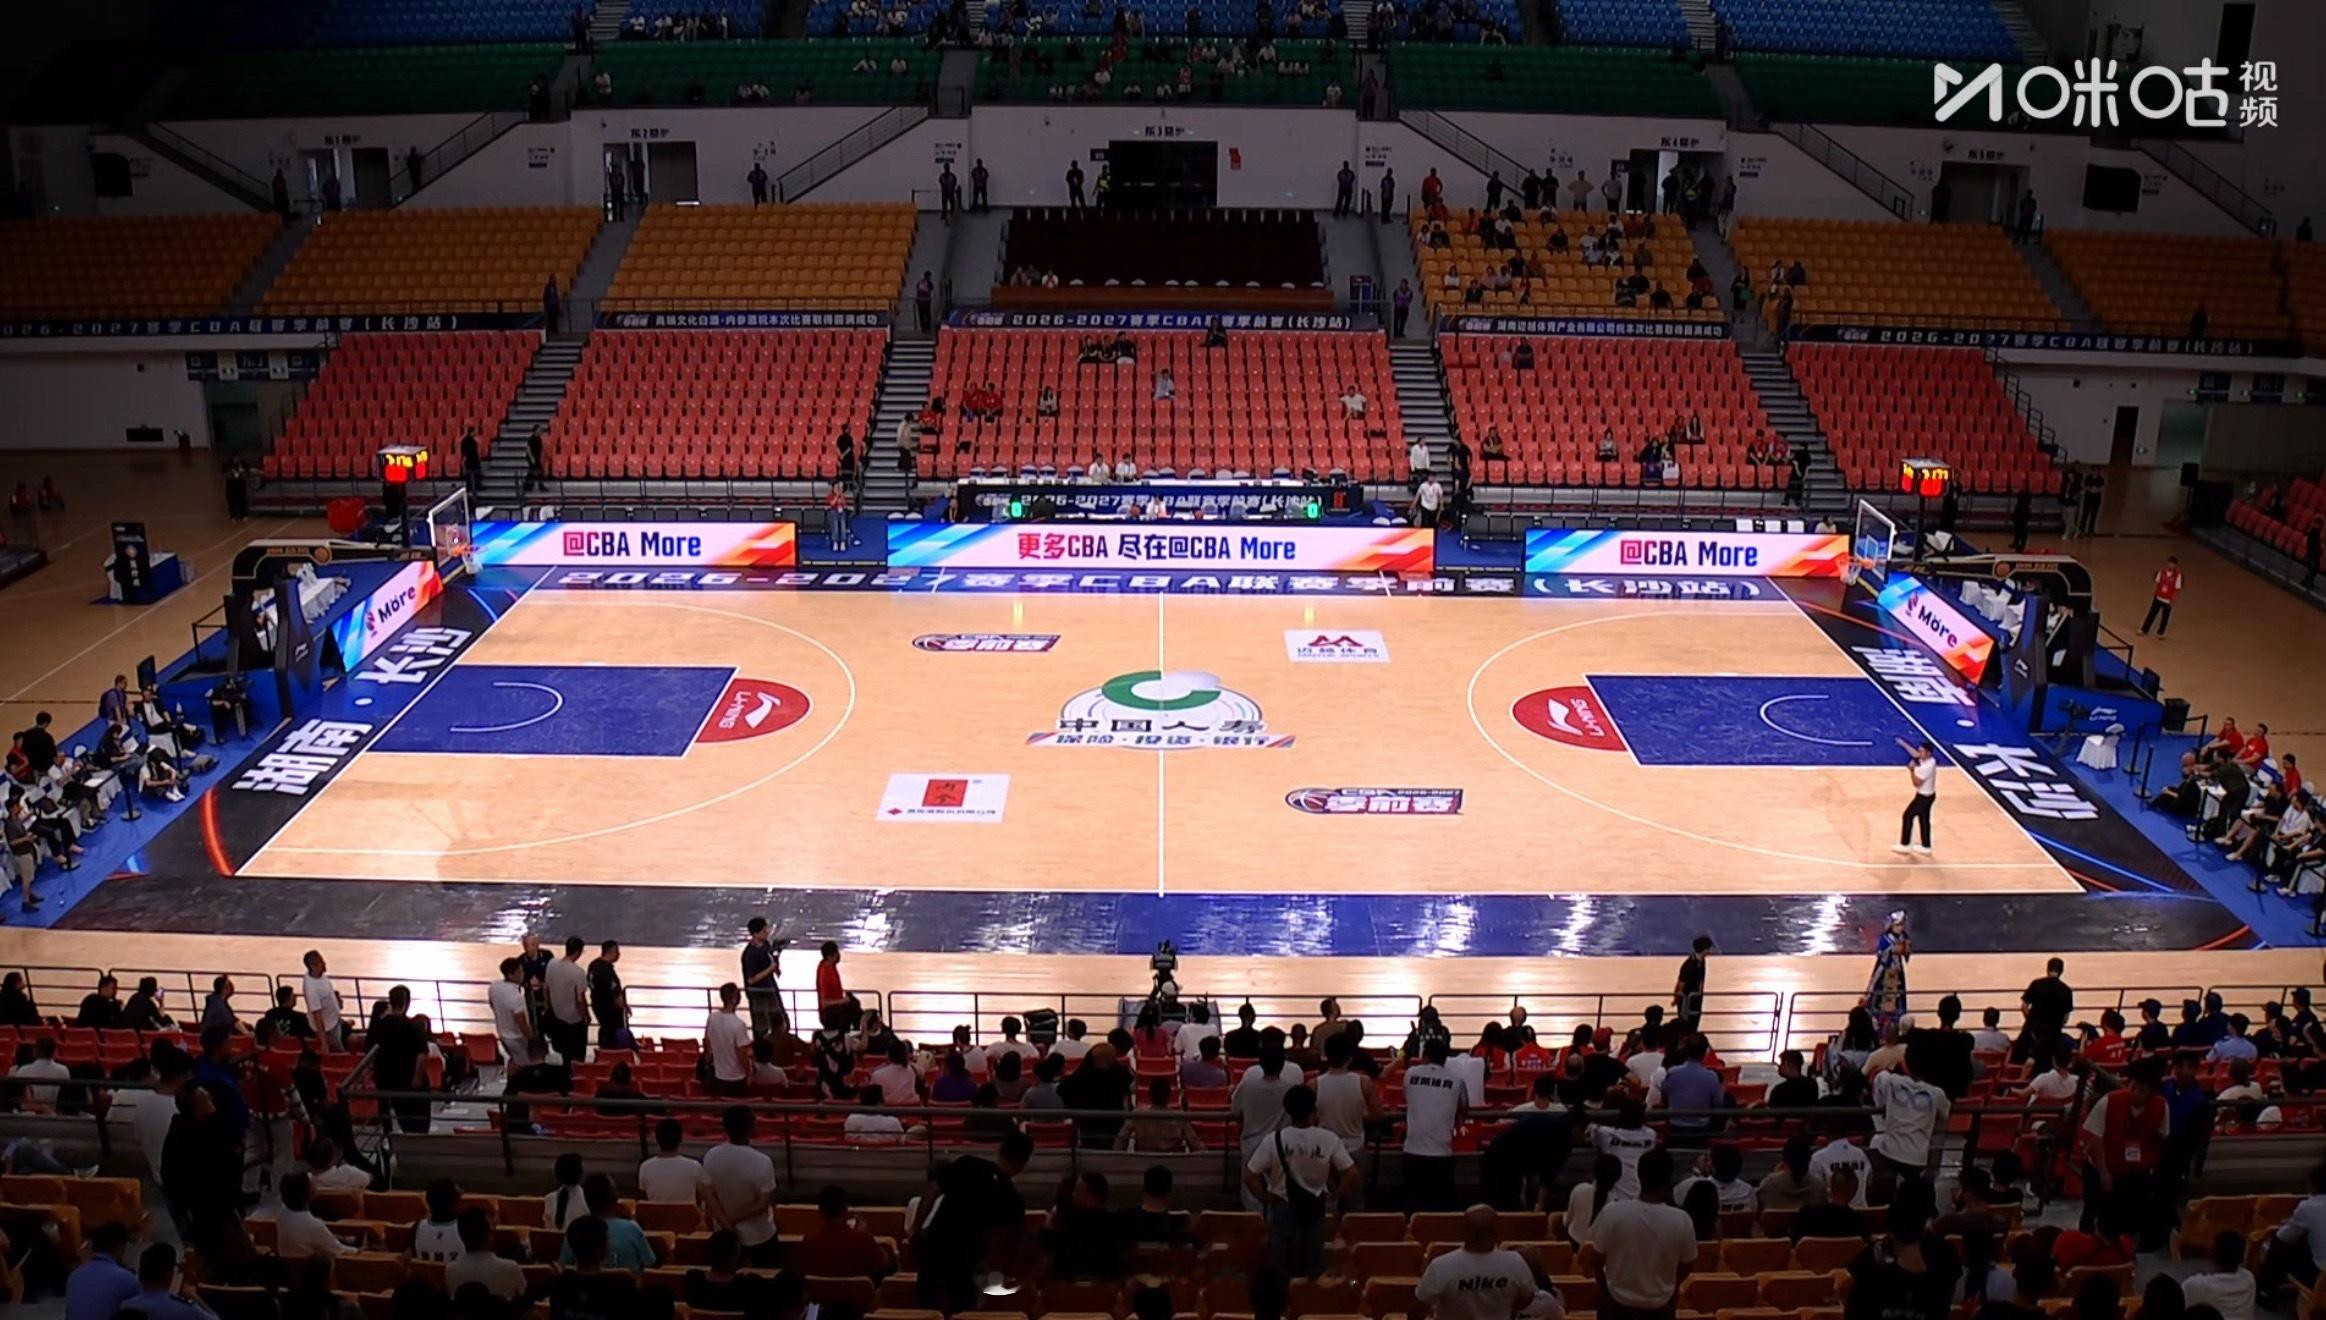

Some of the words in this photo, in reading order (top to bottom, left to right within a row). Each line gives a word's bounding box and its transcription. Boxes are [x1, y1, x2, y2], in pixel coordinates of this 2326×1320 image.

[563, 531, 630, 557] @CBA
[641, 532, 701, 557] More
[1017, 532, 1107, 560] 更多CBA
[1118, 533, 1230, 561] 尽在@CBA
[1240, 533, 1297, 561] More
[1620, 541, 1687, 567] @CBA
[1698, 542, 1758, 568] More
[378, 586, 416, 623] More
[1918, 605, 1957, 648] More
